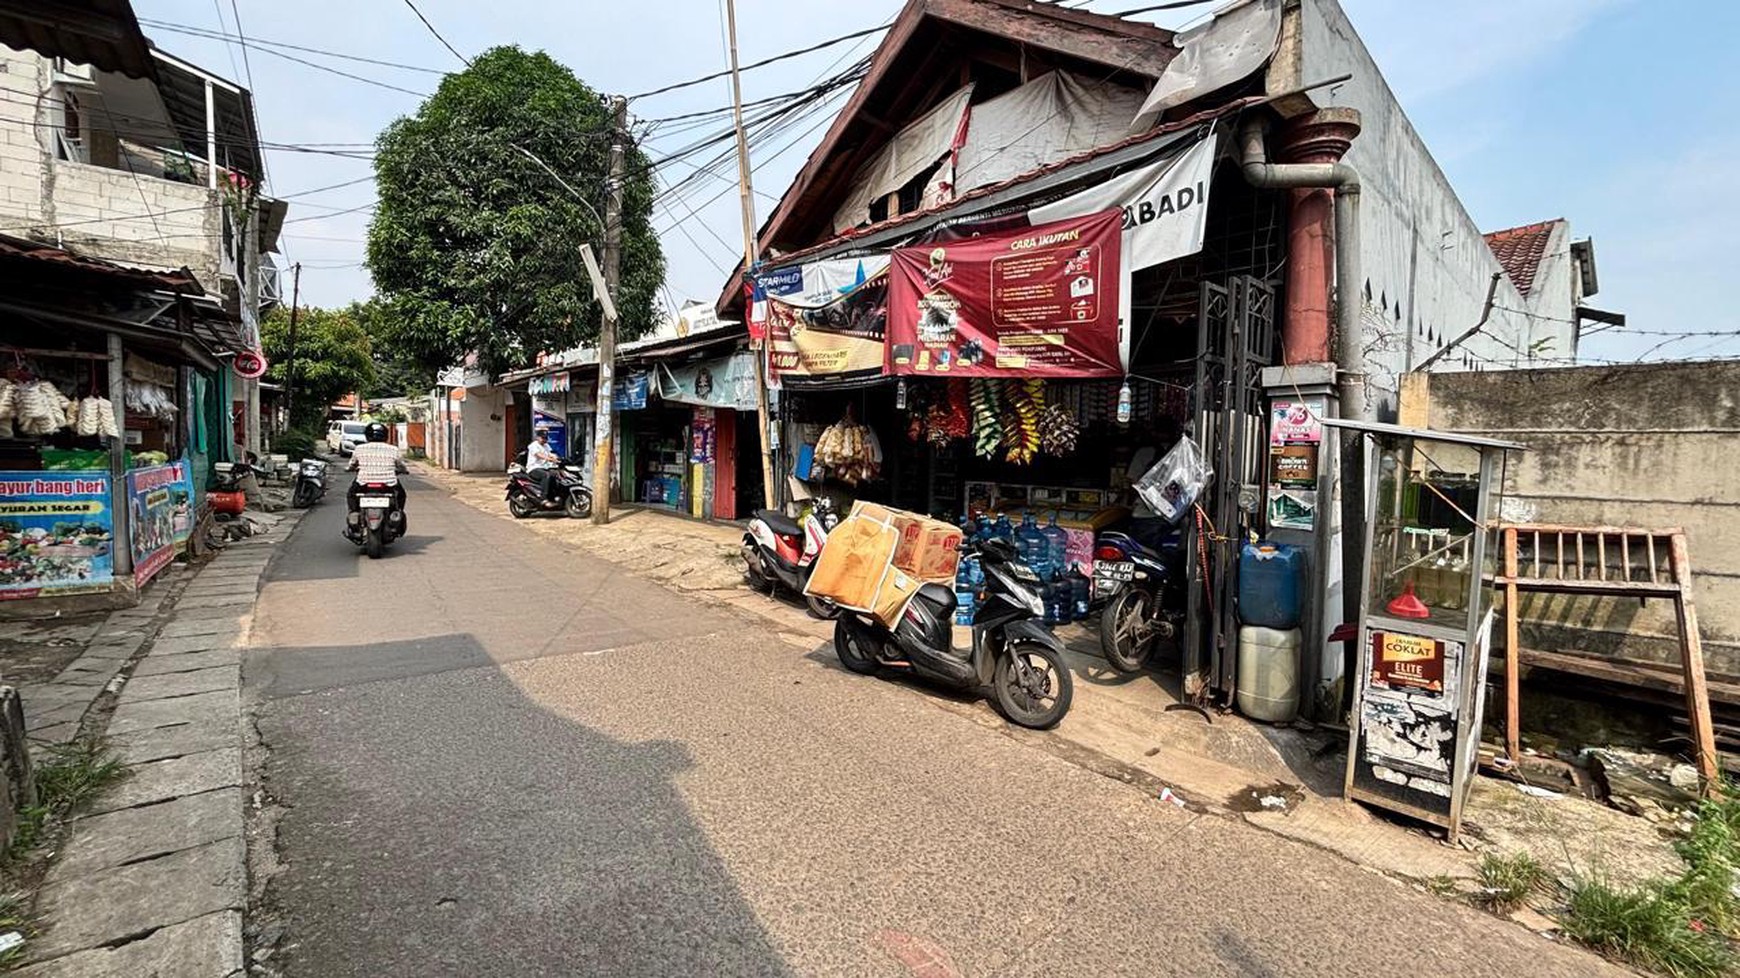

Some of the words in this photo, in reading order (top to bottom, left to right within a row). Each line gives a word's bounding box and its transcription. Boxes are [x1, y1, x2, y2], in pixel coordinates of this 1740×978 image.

[1011, 238, 1036, 250] CARA
[1039, 230, 1079, 246] IKUTAN
[758, 273, 800, 287] STARMILD
[34, 479, 73, 496] bang
[75, 479, 106, 493] heri
[51, 504, 90, 512] SEGAR
[1386, 643, 1432, 656] COKLAT
[1394, 662, 1424, 675] ELITE
